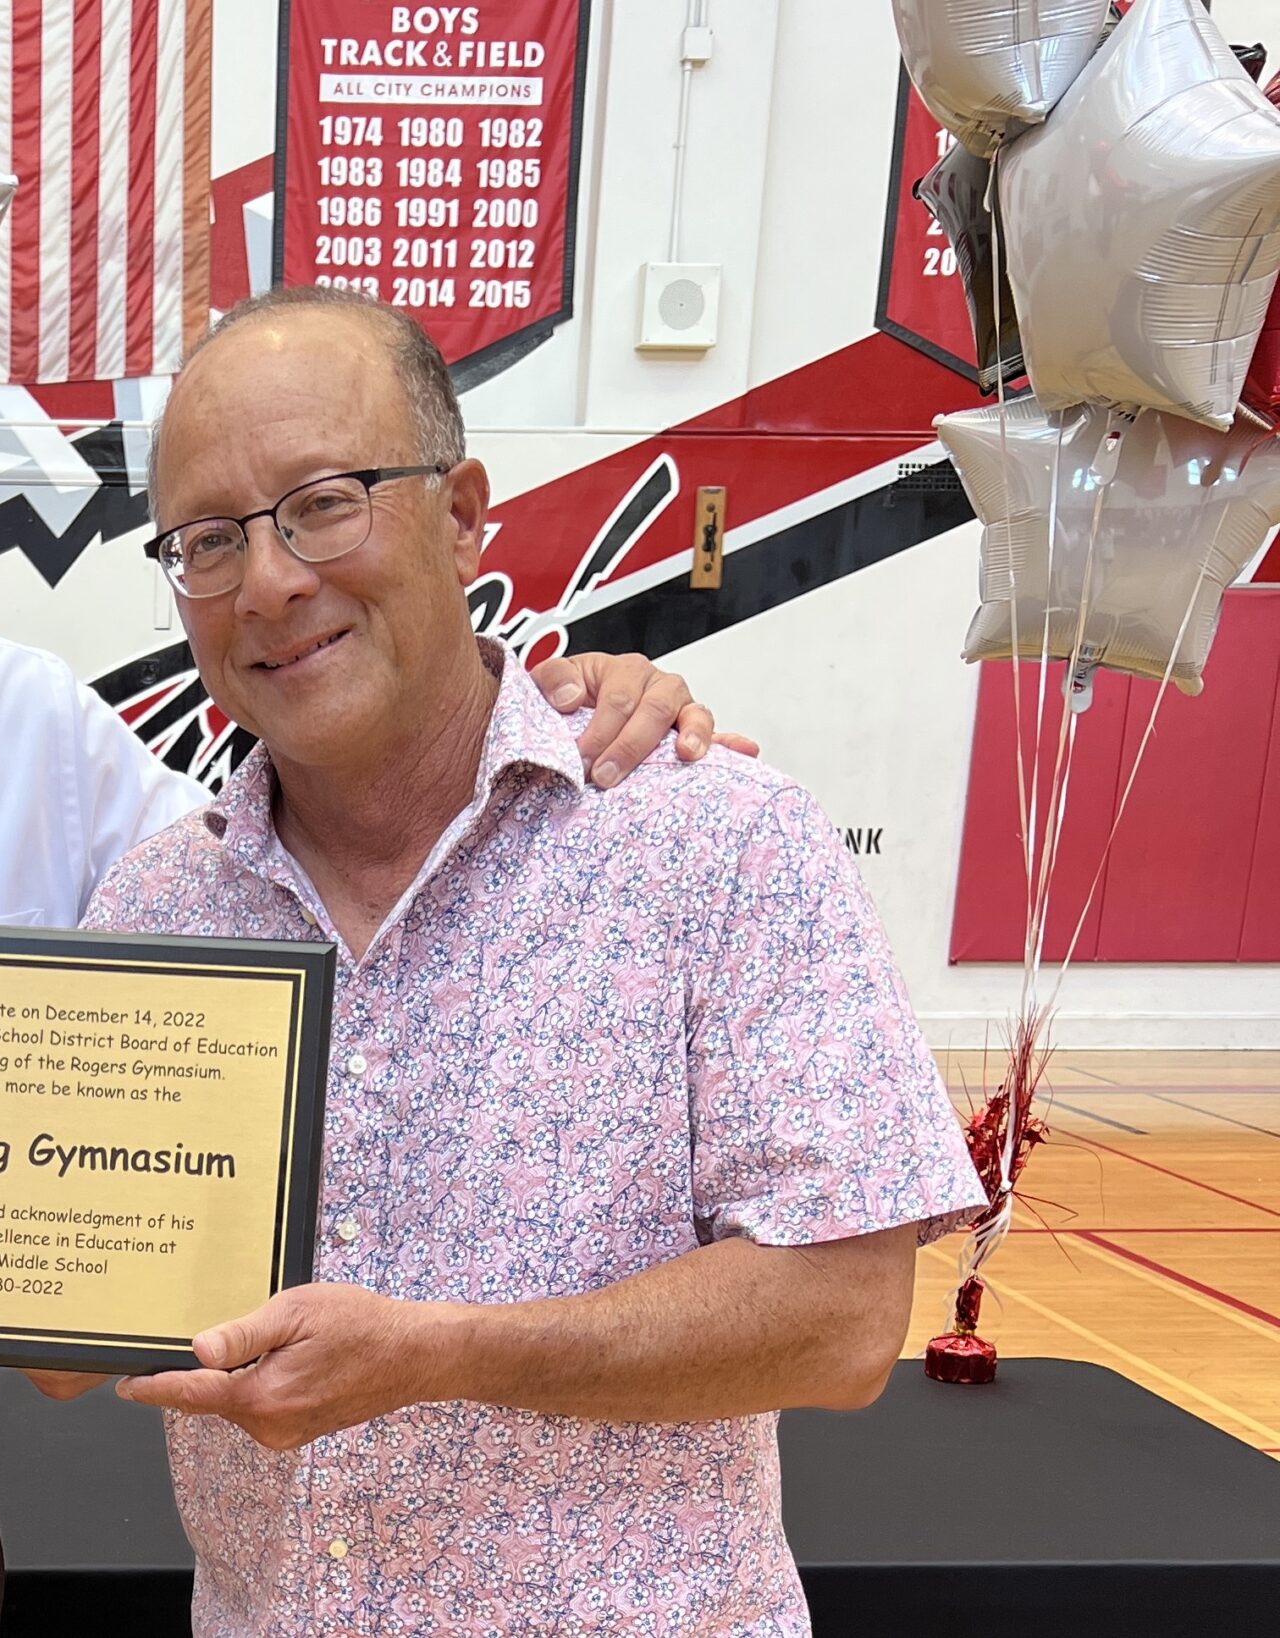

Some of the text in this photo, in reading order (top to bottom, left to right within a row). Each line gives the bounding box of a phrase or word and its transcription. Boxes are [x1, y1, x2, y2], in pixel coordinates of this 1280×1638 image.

[391, 6, 479, 34] BOYS
[320, 38, 545, 68] TRACK & FIELD
[333, 82, 532, 98] ALL CITY CHAMPIONS
[319, 116, 543, 149] 1974 1980 1982
[317, 156, 541, 188] 1983 1984 1985
[317, 196, 539, 228] 1986 1991 2000
[315, 236, 536, 269] 2003 2011 2012
[923, 247, 957, 276] 20
[391, 277, 456, 307] 2014
[468, 279, 531, 309] 2015
[21, 1007, 40, 1021] on
[45, 1004, 129, 1025] December
[133, 1009, 158, 1029] 14,
[162, 1010, 206, 1029] 2022
[49, 1029, 115, 1049] District
[120, 1033, 169, 1052] Board
[172, 1036, 193, 1054] of
[196, 1037, 278, 1058] Education
[13, 1052, 33, 1071] of
[37, 1053, 66, 1071] the
[70, 1055, 127, 1078] Rogers
[131, 1059, 225, 1081] Gymnasium.
[5, 1080, 47, 1095] more
[51, 1079, 72, 1097] be
[76, 1080, 126, 1100] known
[129, 1088, 149, 1101] as
[153, 1085, 182, 1103] the
[27, 1132, 236, 1179] Gymnasium
[10, 1205, 143, 1230] acknowledgment
[147, 1212, 166, 1230] of
[170, 1213, 195, 1231] his
[55, 1231, 70, 1249] in
[74, 1232, 155, 1254] Education
[158, 1240, 177, 1255] at
[54, 1256, 108, 1275] School
